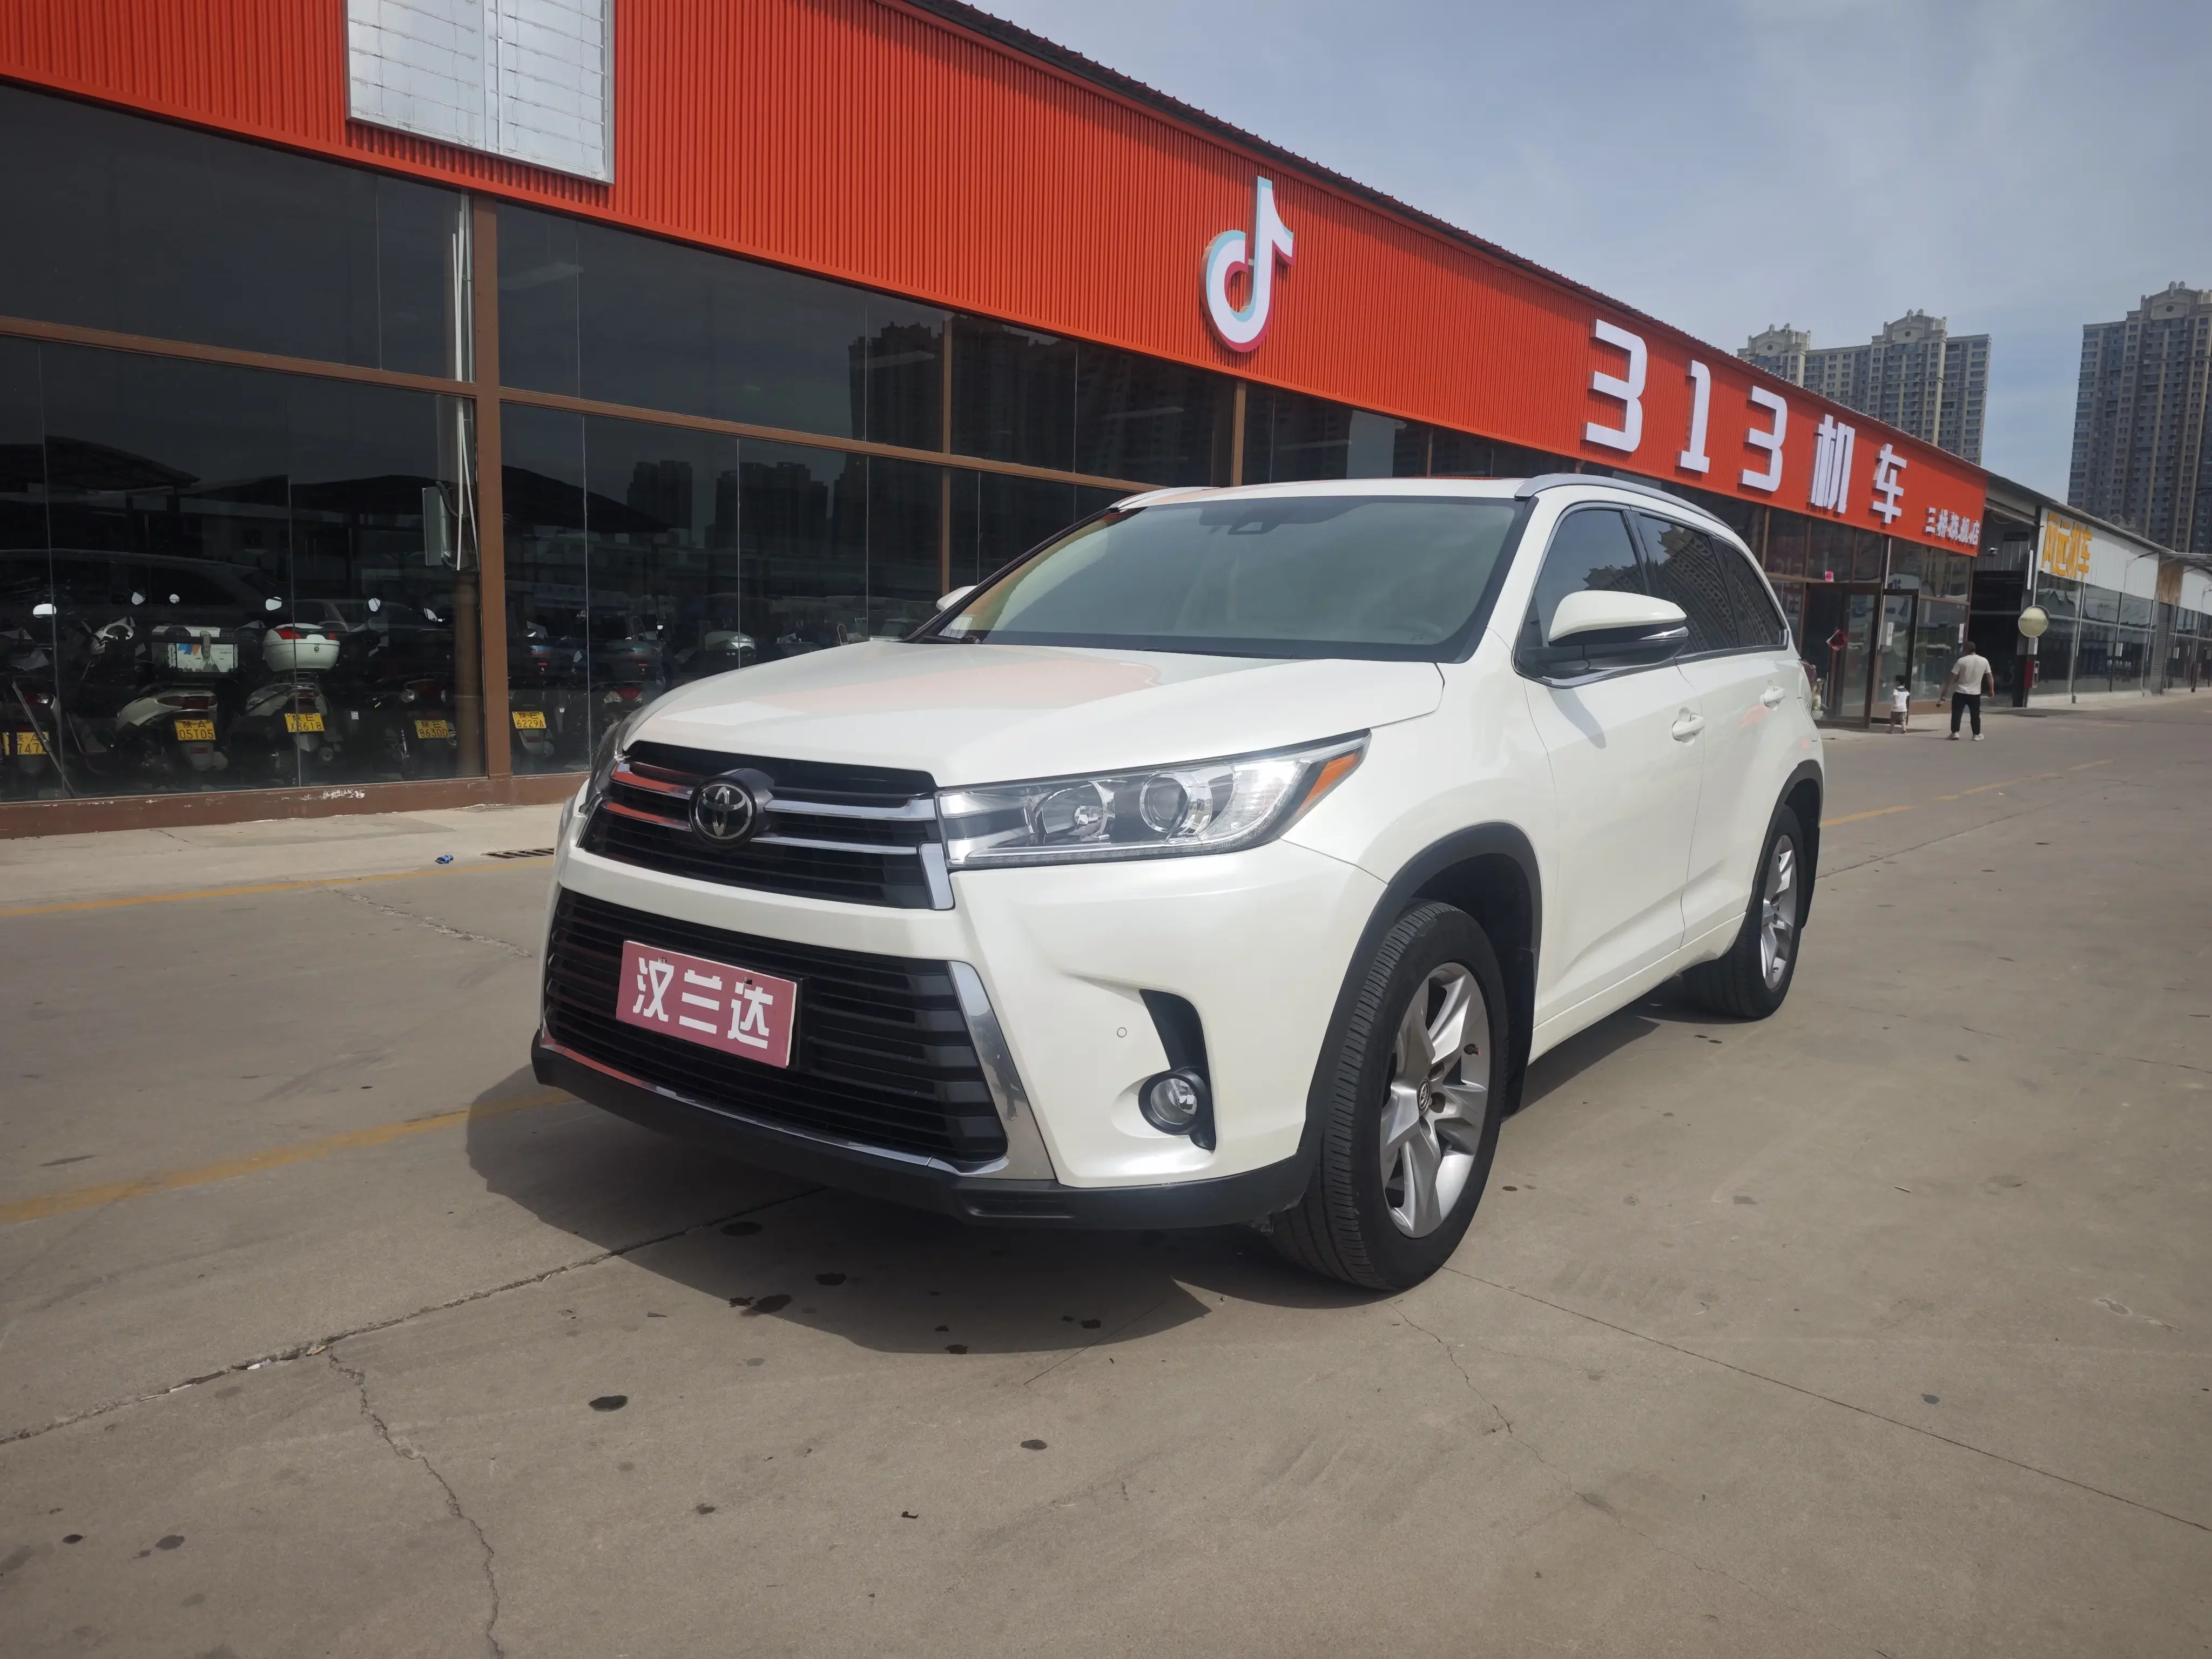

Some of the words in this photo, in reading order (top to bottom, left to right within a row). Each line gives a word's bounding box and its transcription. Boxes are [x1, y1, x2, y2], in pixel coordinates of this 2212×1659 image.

[179, 729, 213, 739] 05T05
[632, 957, 773, 1049] 汉兰达
